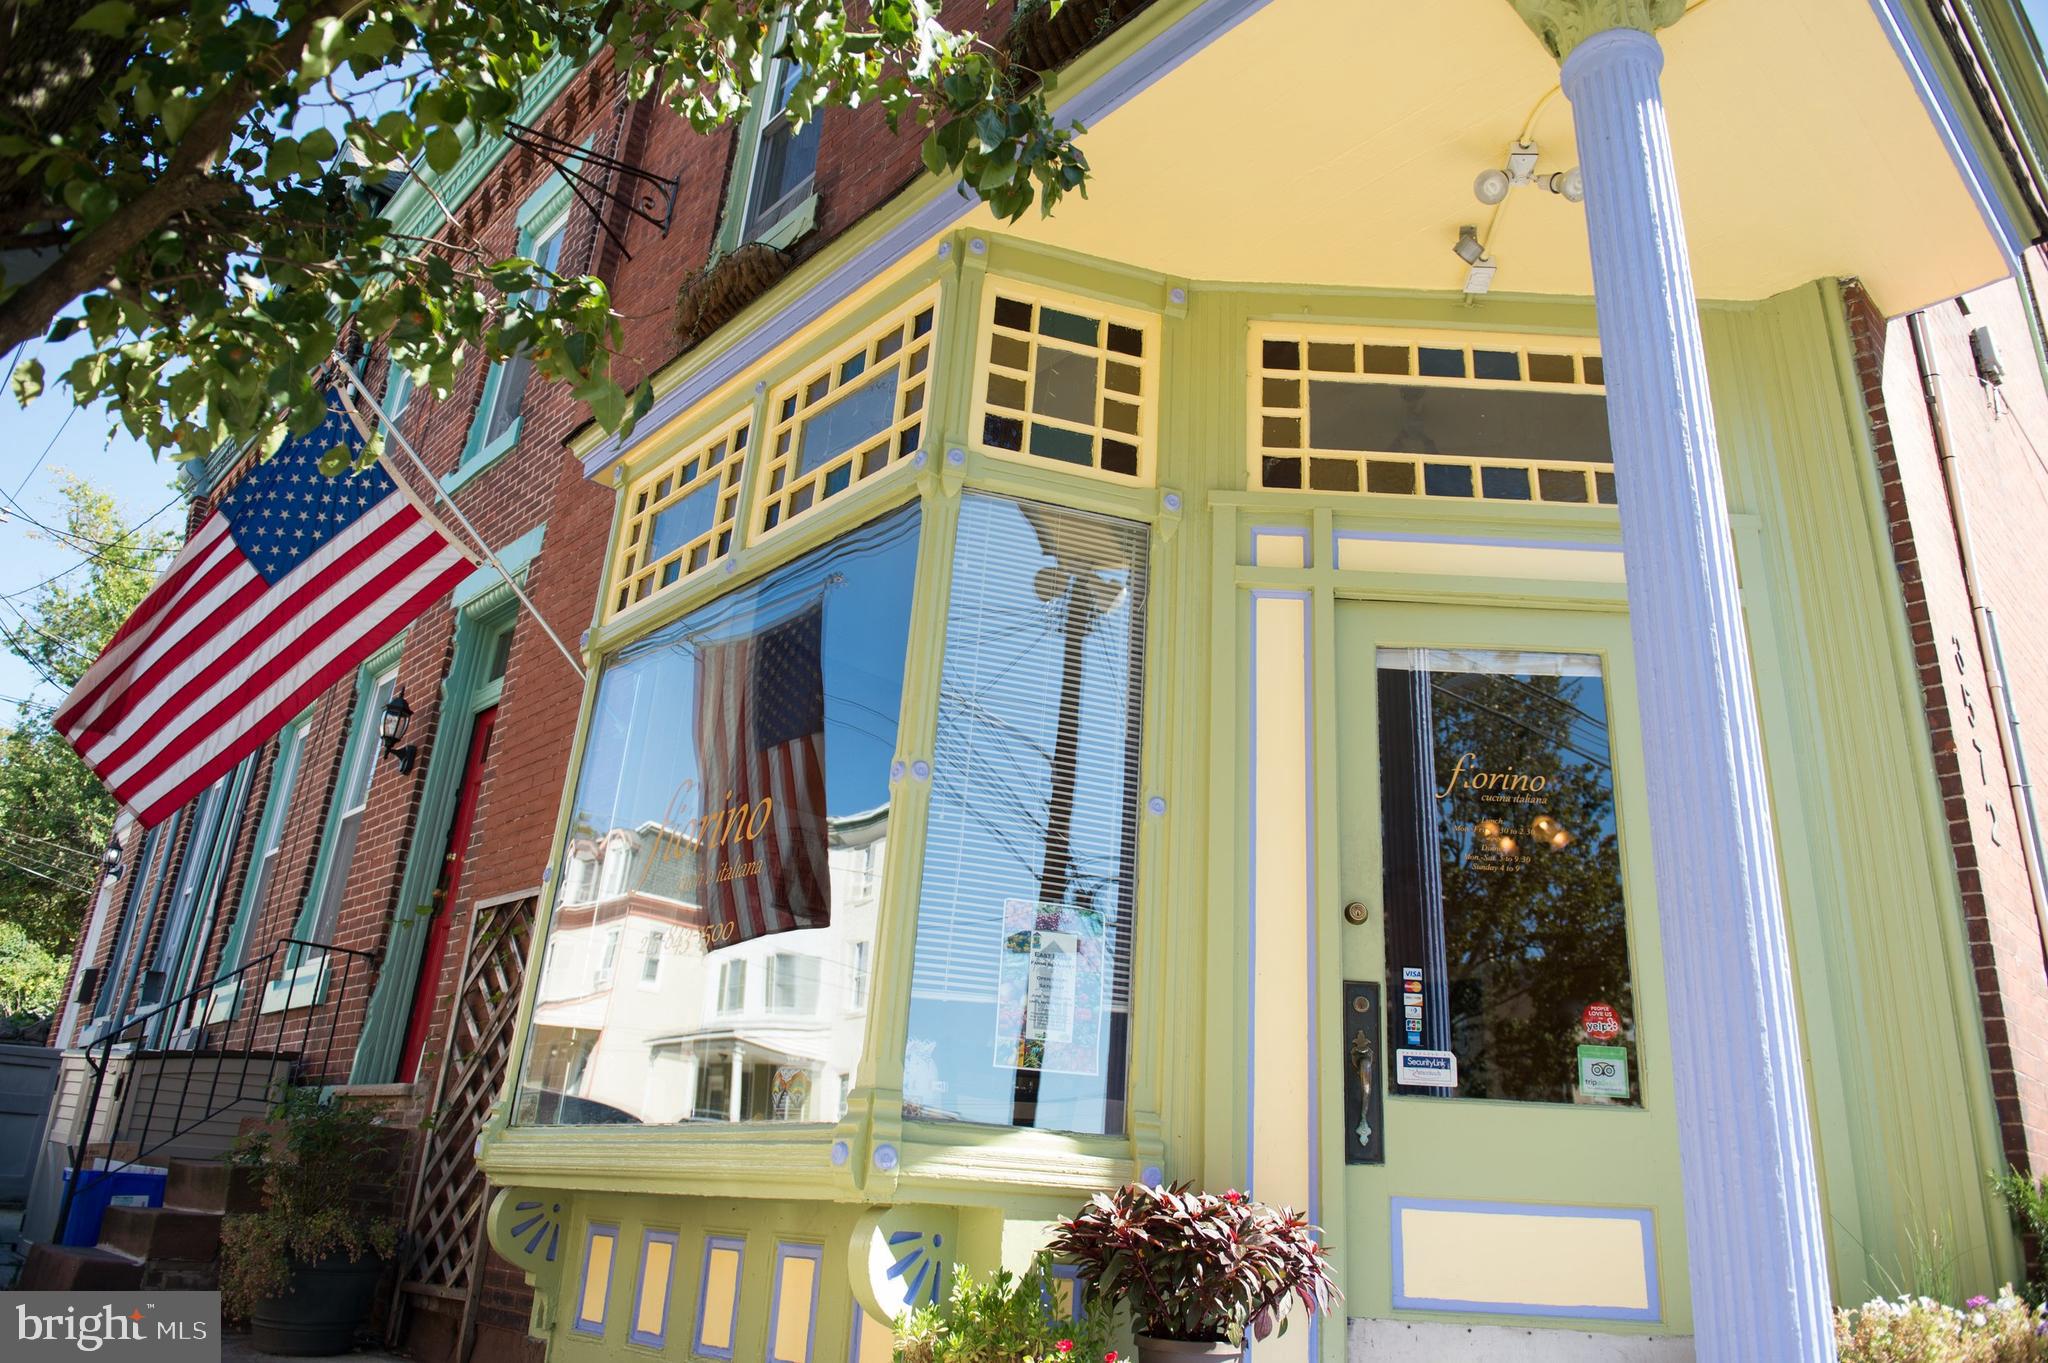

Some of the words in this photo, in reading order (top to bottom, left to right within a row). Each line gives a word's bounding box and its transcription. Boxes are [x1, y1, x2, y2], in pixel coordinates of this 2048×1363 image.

[1435, 752, 1546, 799] fiorino
[1481, 794, 1511, 803] cucina
[1512, 793, 1547, 805] italiana
[716, 854, 764, 884] italiana
[1472, 863, 1498, 873] Sunday
[1586, 1021, 1608, 1033] yelp
[1407, 1057, 1447, 1068] SecurityLink
